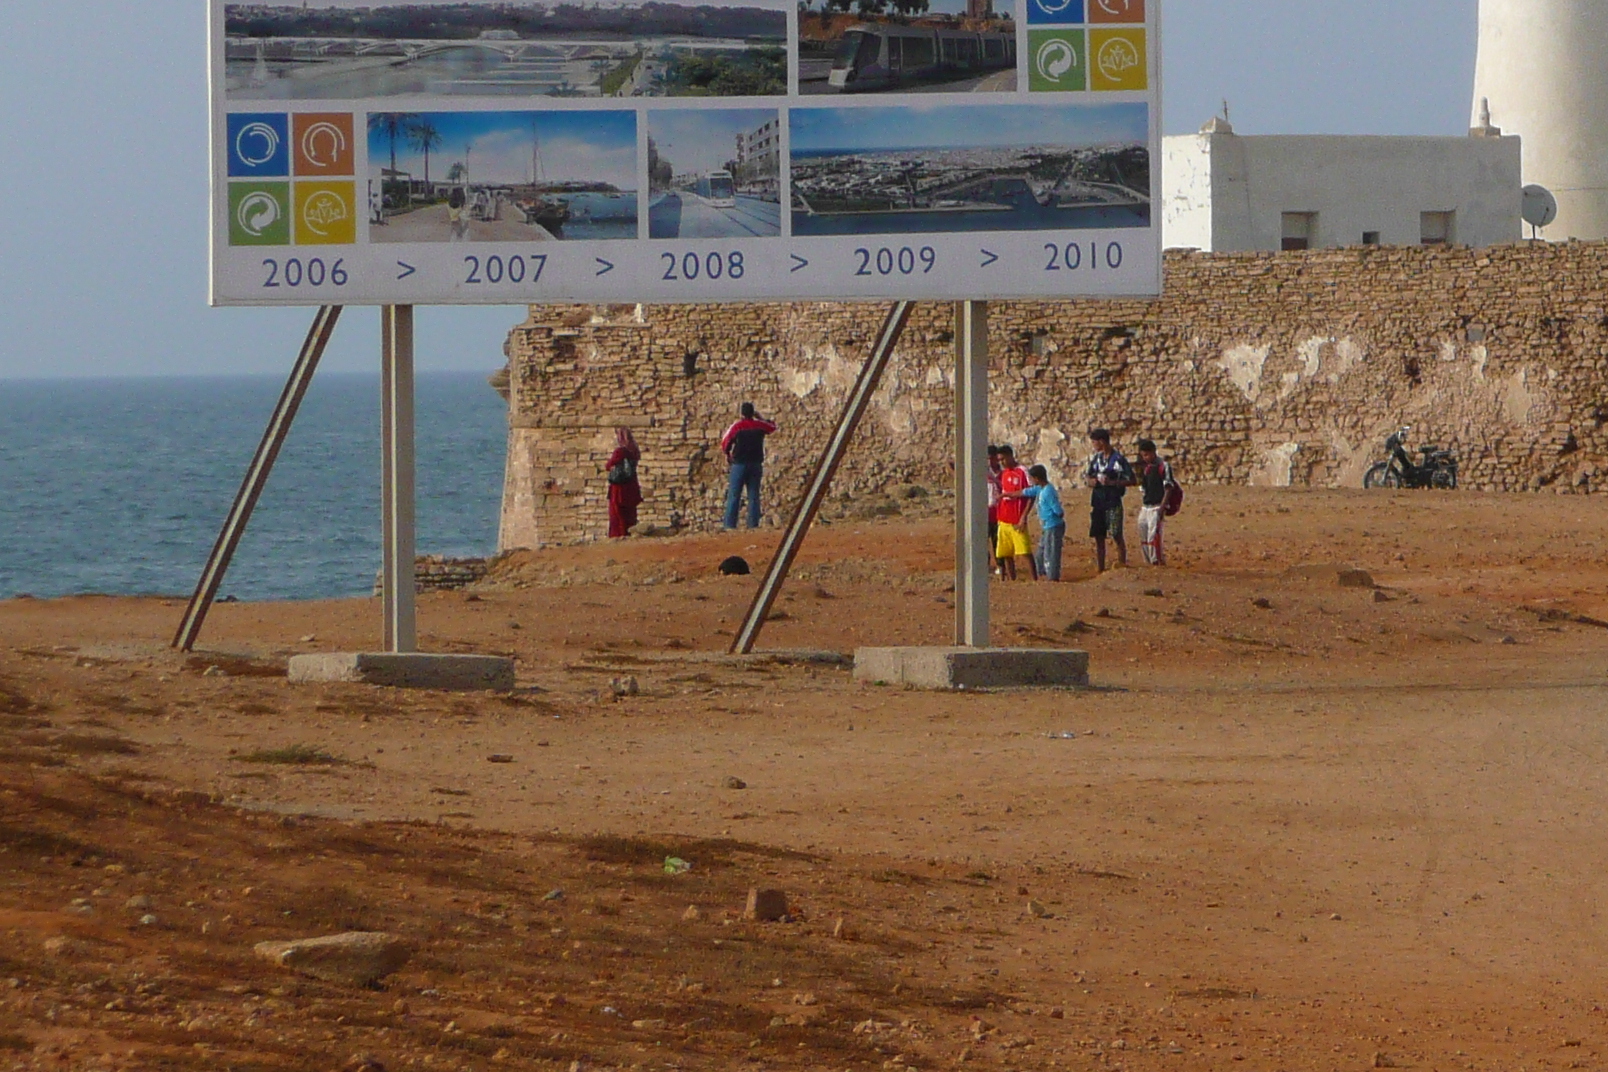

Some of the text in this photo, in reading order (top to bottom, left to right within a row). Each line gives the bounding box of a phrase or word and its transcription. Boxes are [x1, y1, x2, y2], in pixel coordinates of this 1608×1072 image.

[262, 257, 349, 288] 2006
[464, 254, 548, 284] 2007
[661, 250, 745, 281] 2008
[853, 246, 936, 276] 2009
[1043, 241, 1123, 271] 2010
